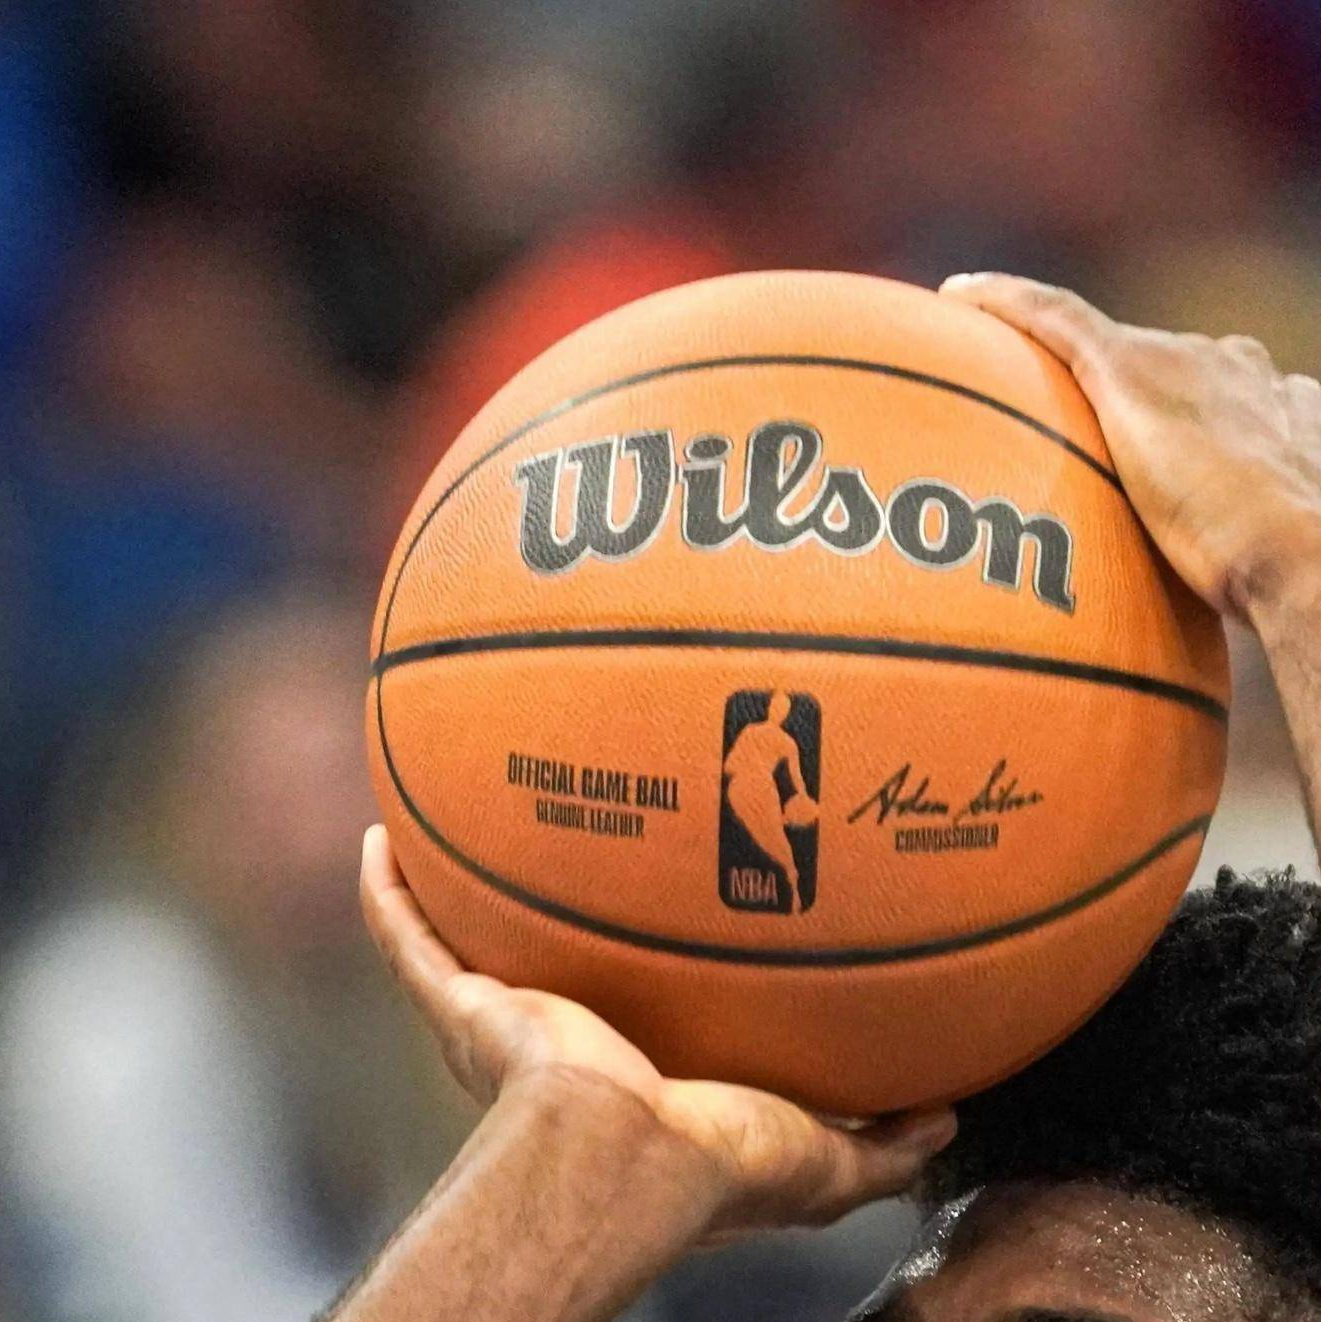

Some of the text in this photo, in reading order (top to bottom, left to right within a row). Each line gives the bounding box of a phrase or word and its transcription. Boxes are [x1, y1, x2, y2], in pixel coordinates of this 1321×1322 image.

[513, 420, 1076, 615] Wilson
[507, 752, 680, 813] OFFICIAL GAME BALL
[535, 798, 644, 839] GENUINE LEATHER
[894, 822, 999, 854] COMMISSIONER
[730, 866, 779, 905] NBA
